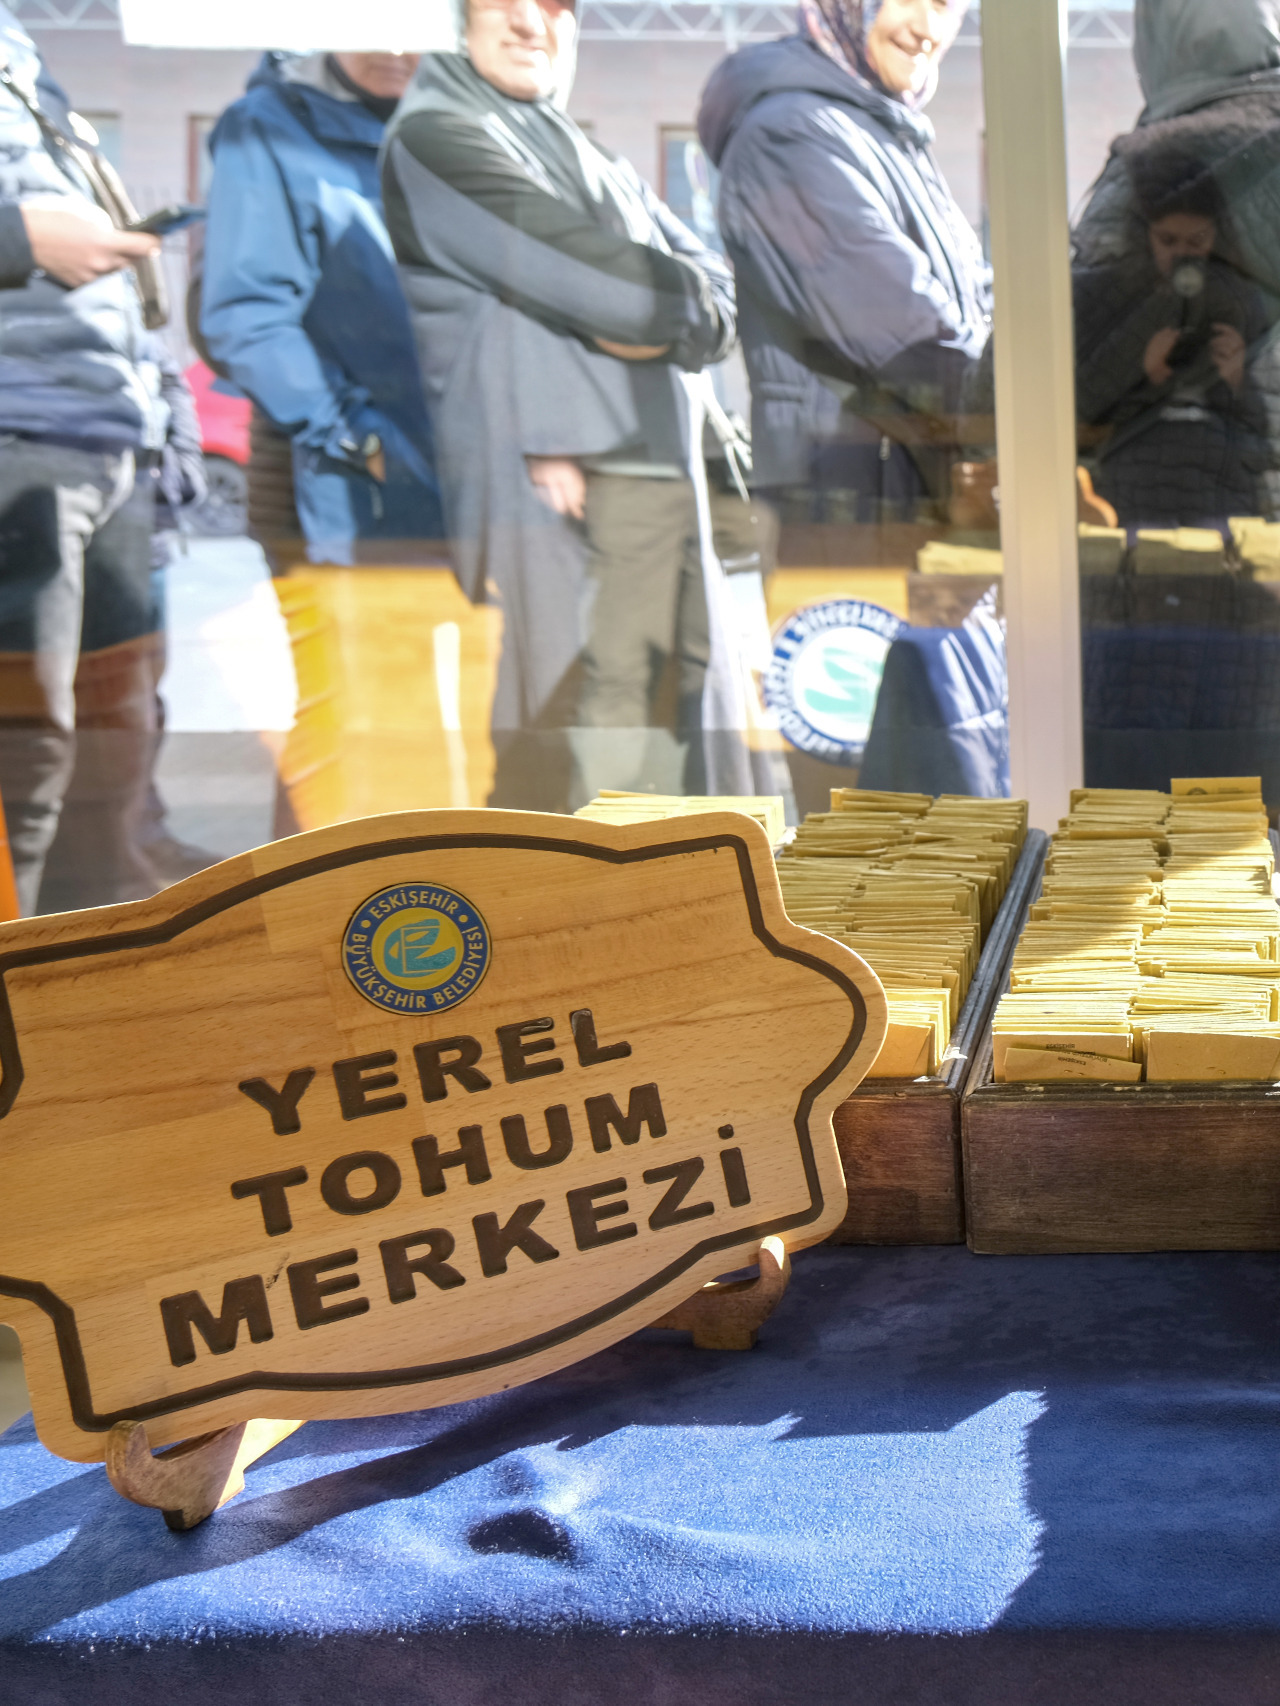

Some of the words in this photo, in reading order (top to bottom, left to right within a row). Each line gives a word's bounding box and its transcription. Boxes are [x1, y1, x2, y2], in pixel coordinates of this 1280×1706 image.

[351, 933, 427, 1009] BÜYÜKŞEHİR
[432, 925, 484, 1006] BELEDİYESİ
[369, 889, 459, 919] ESKİŞEHİR
[237, 1007, 633, 1137] YEREL
[230, 1082, 668, 1237] TOHUM
[158, 1124, 753, 1368] MERKEZİ
